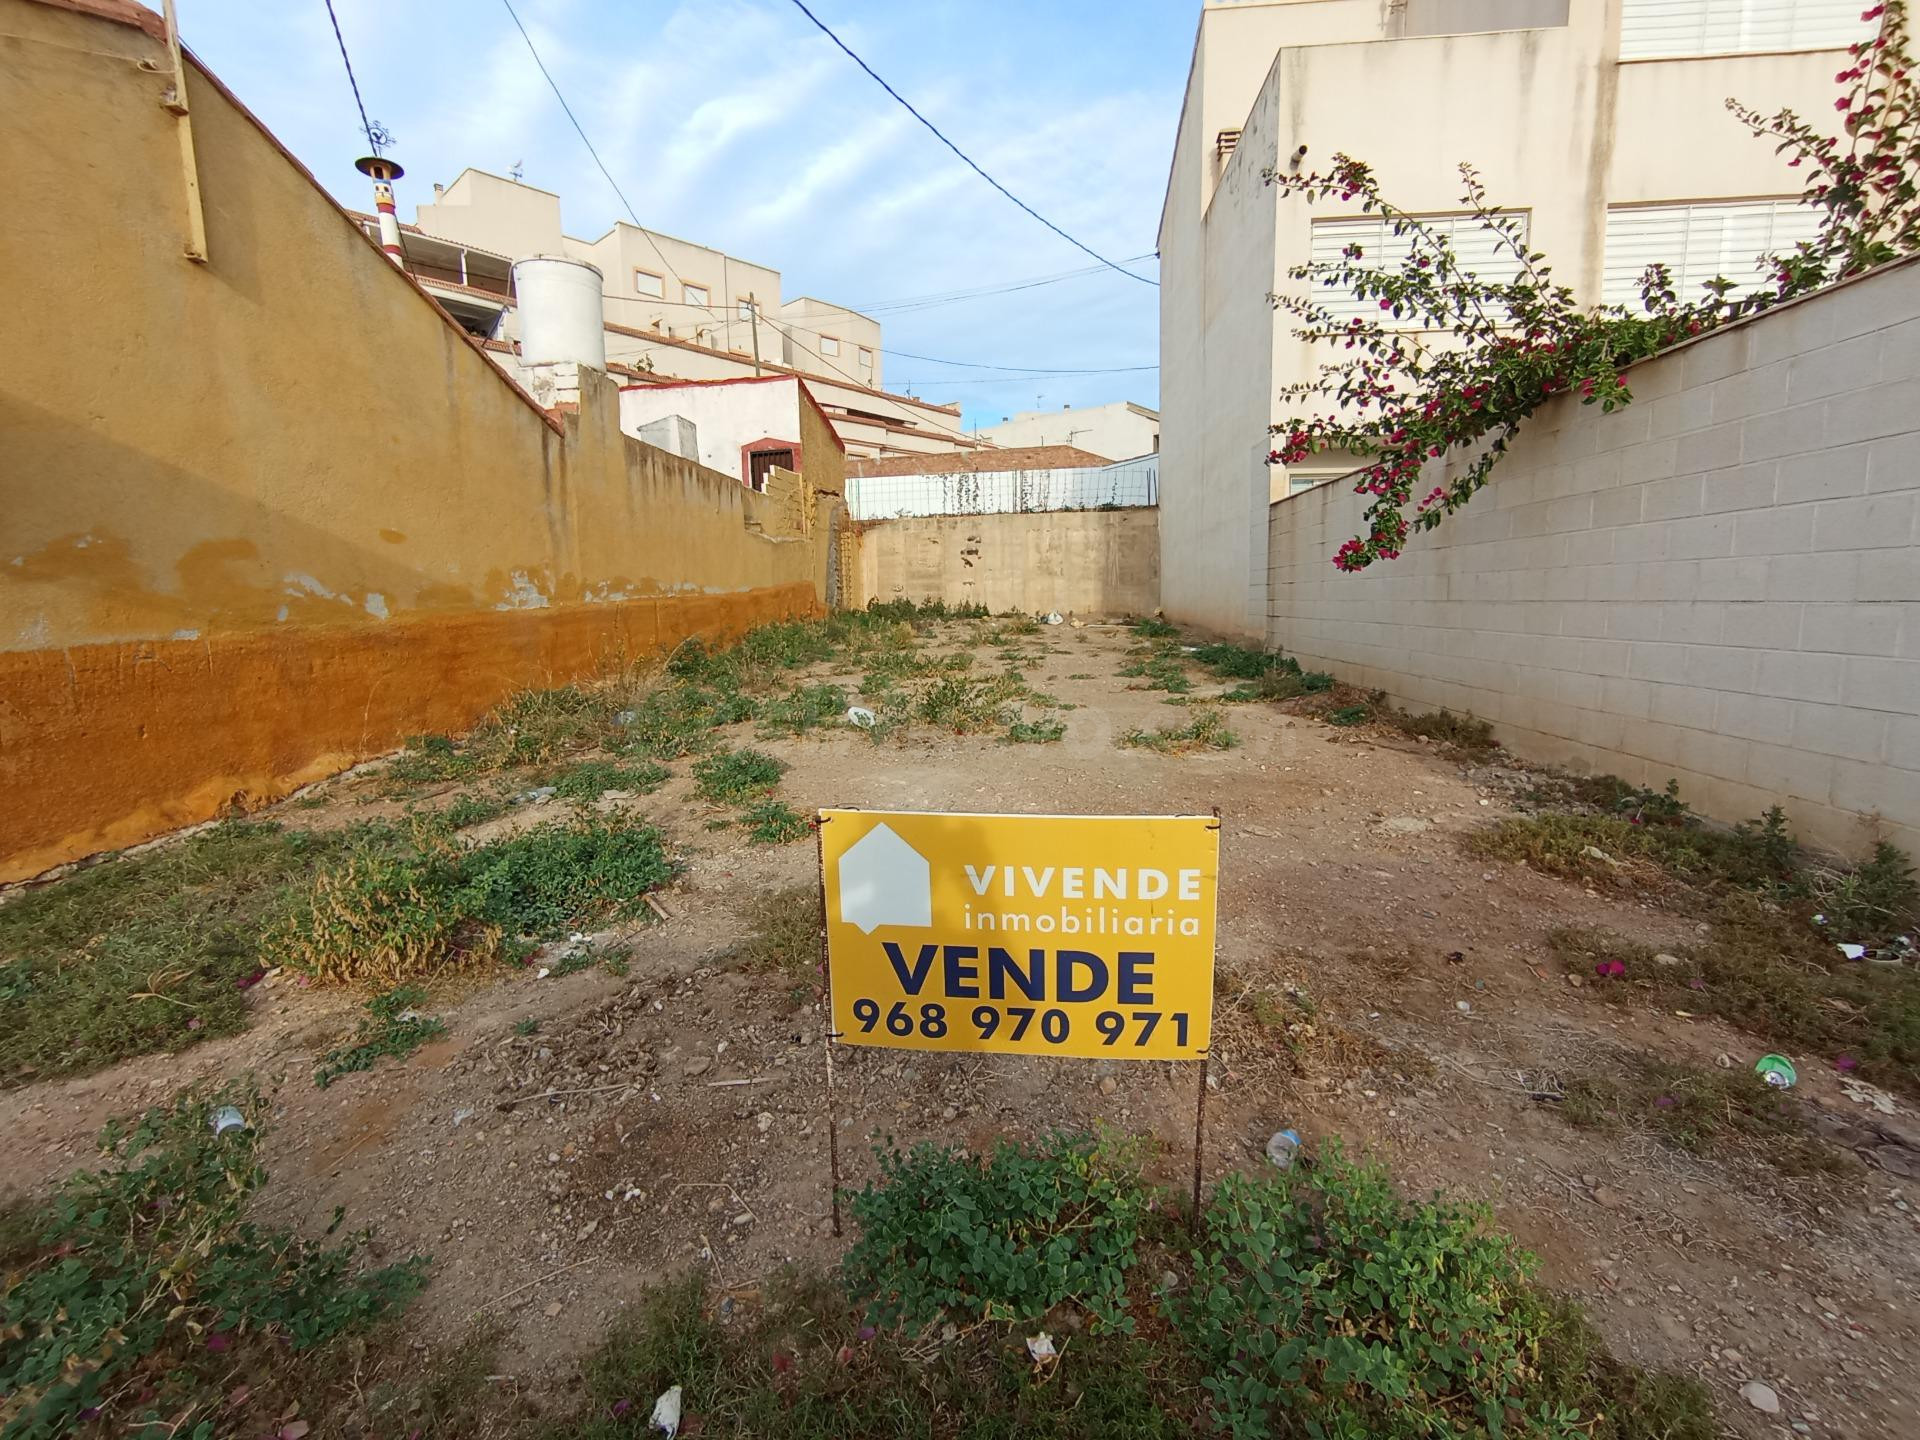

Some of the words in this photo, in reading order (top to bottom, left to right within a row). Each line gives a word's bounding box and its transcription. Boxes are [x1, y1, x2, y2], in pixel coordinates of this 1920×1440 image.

[964, 864, 1201, 901] VIVENDE
[964, 903, 1200, 936] inmobiliaria
[882, 941, 1155, 1006] VENDE
[852, 998, 949, 1039] 968
[971, 1005, 1070, 1045] 970
[1095, 1011, 1189, 1047] 971
